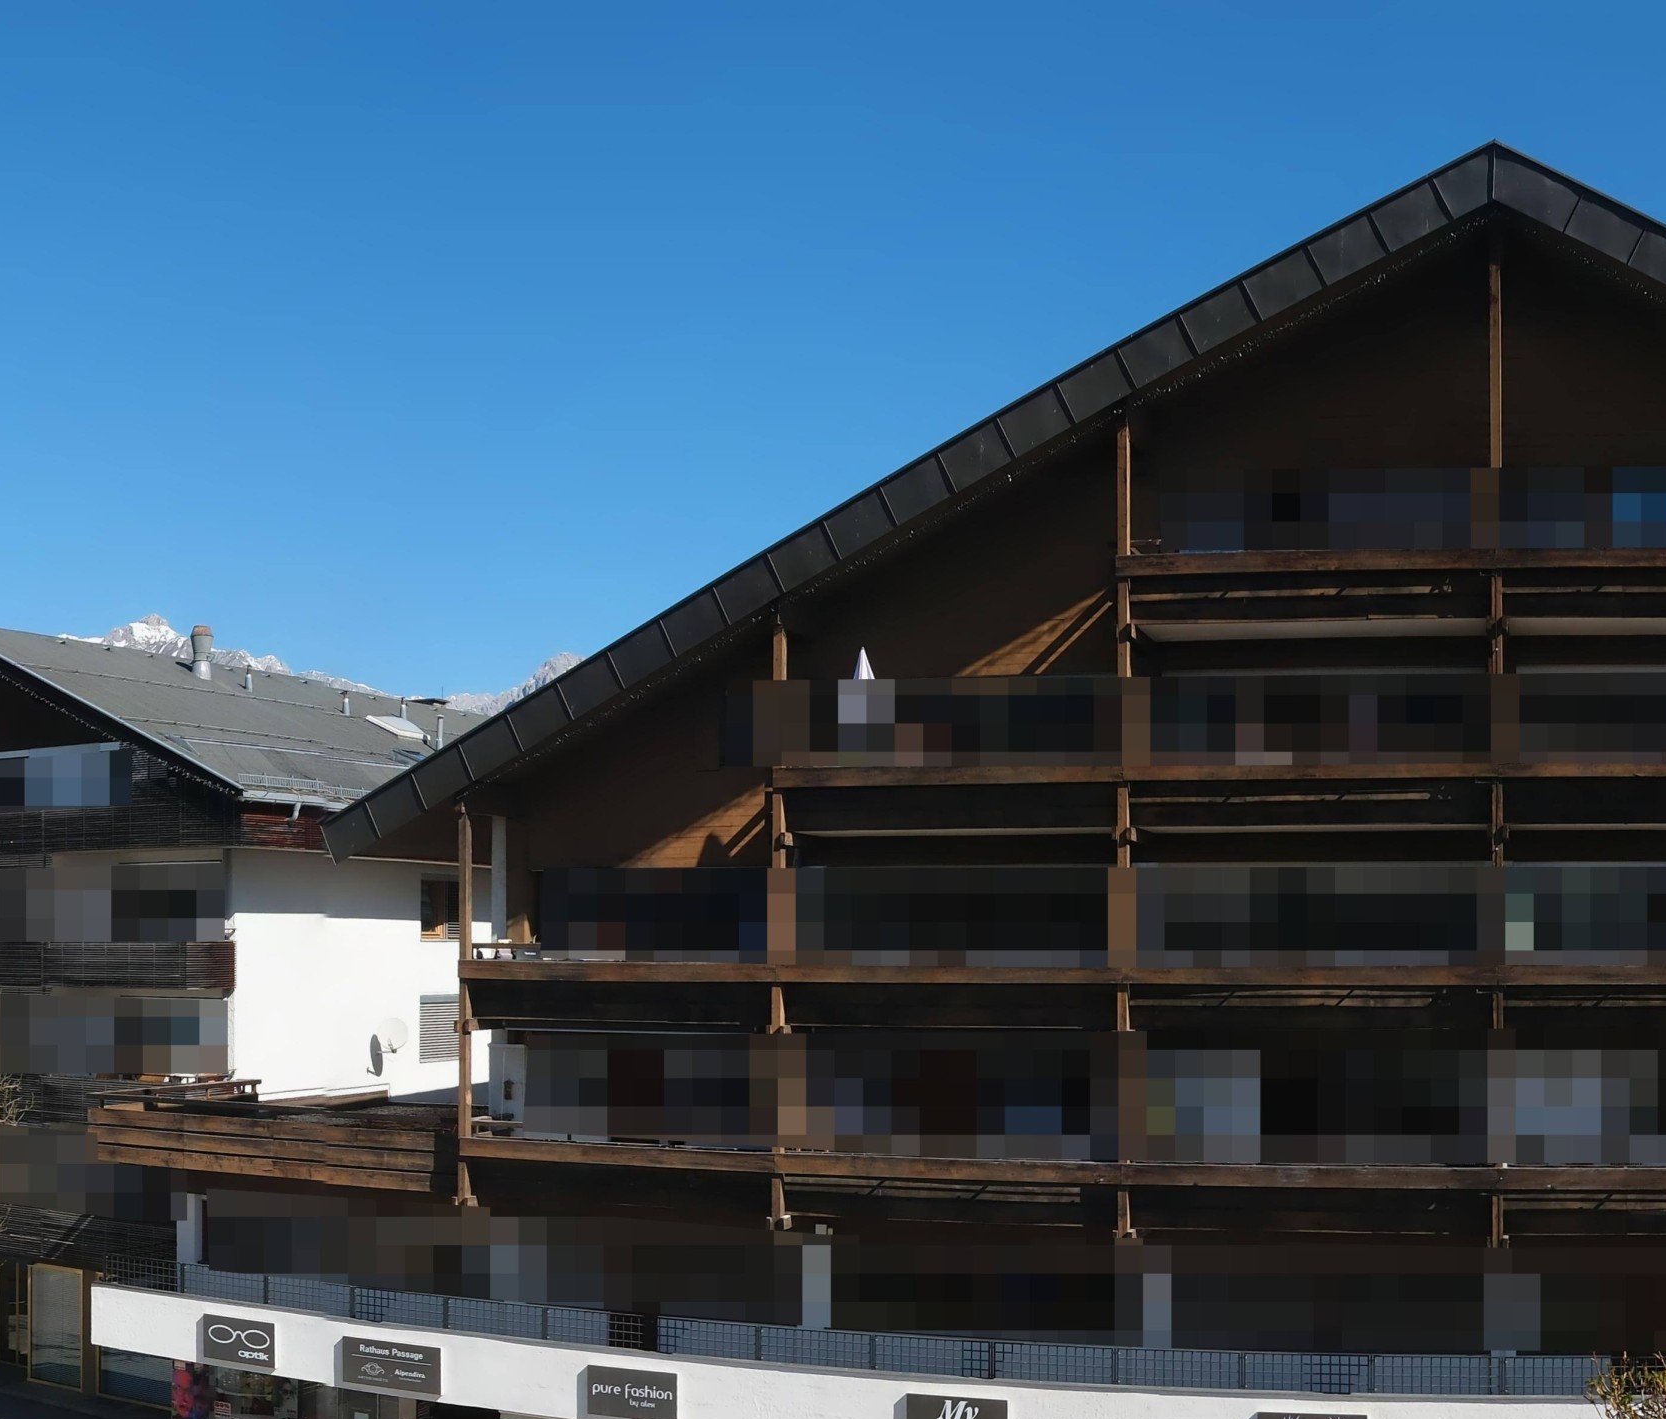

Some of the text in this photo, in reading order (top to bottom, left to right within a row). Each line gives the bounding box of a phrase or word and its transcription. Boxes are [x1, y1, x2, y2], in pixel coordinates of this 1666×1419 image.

[238, 1350, 270, 1361] optik
[359, 1344, 424, 1360] Rathaus Passage
[592, 1383, 673, 1400] pure fashion
[629, 1399, 639, 1408] by
